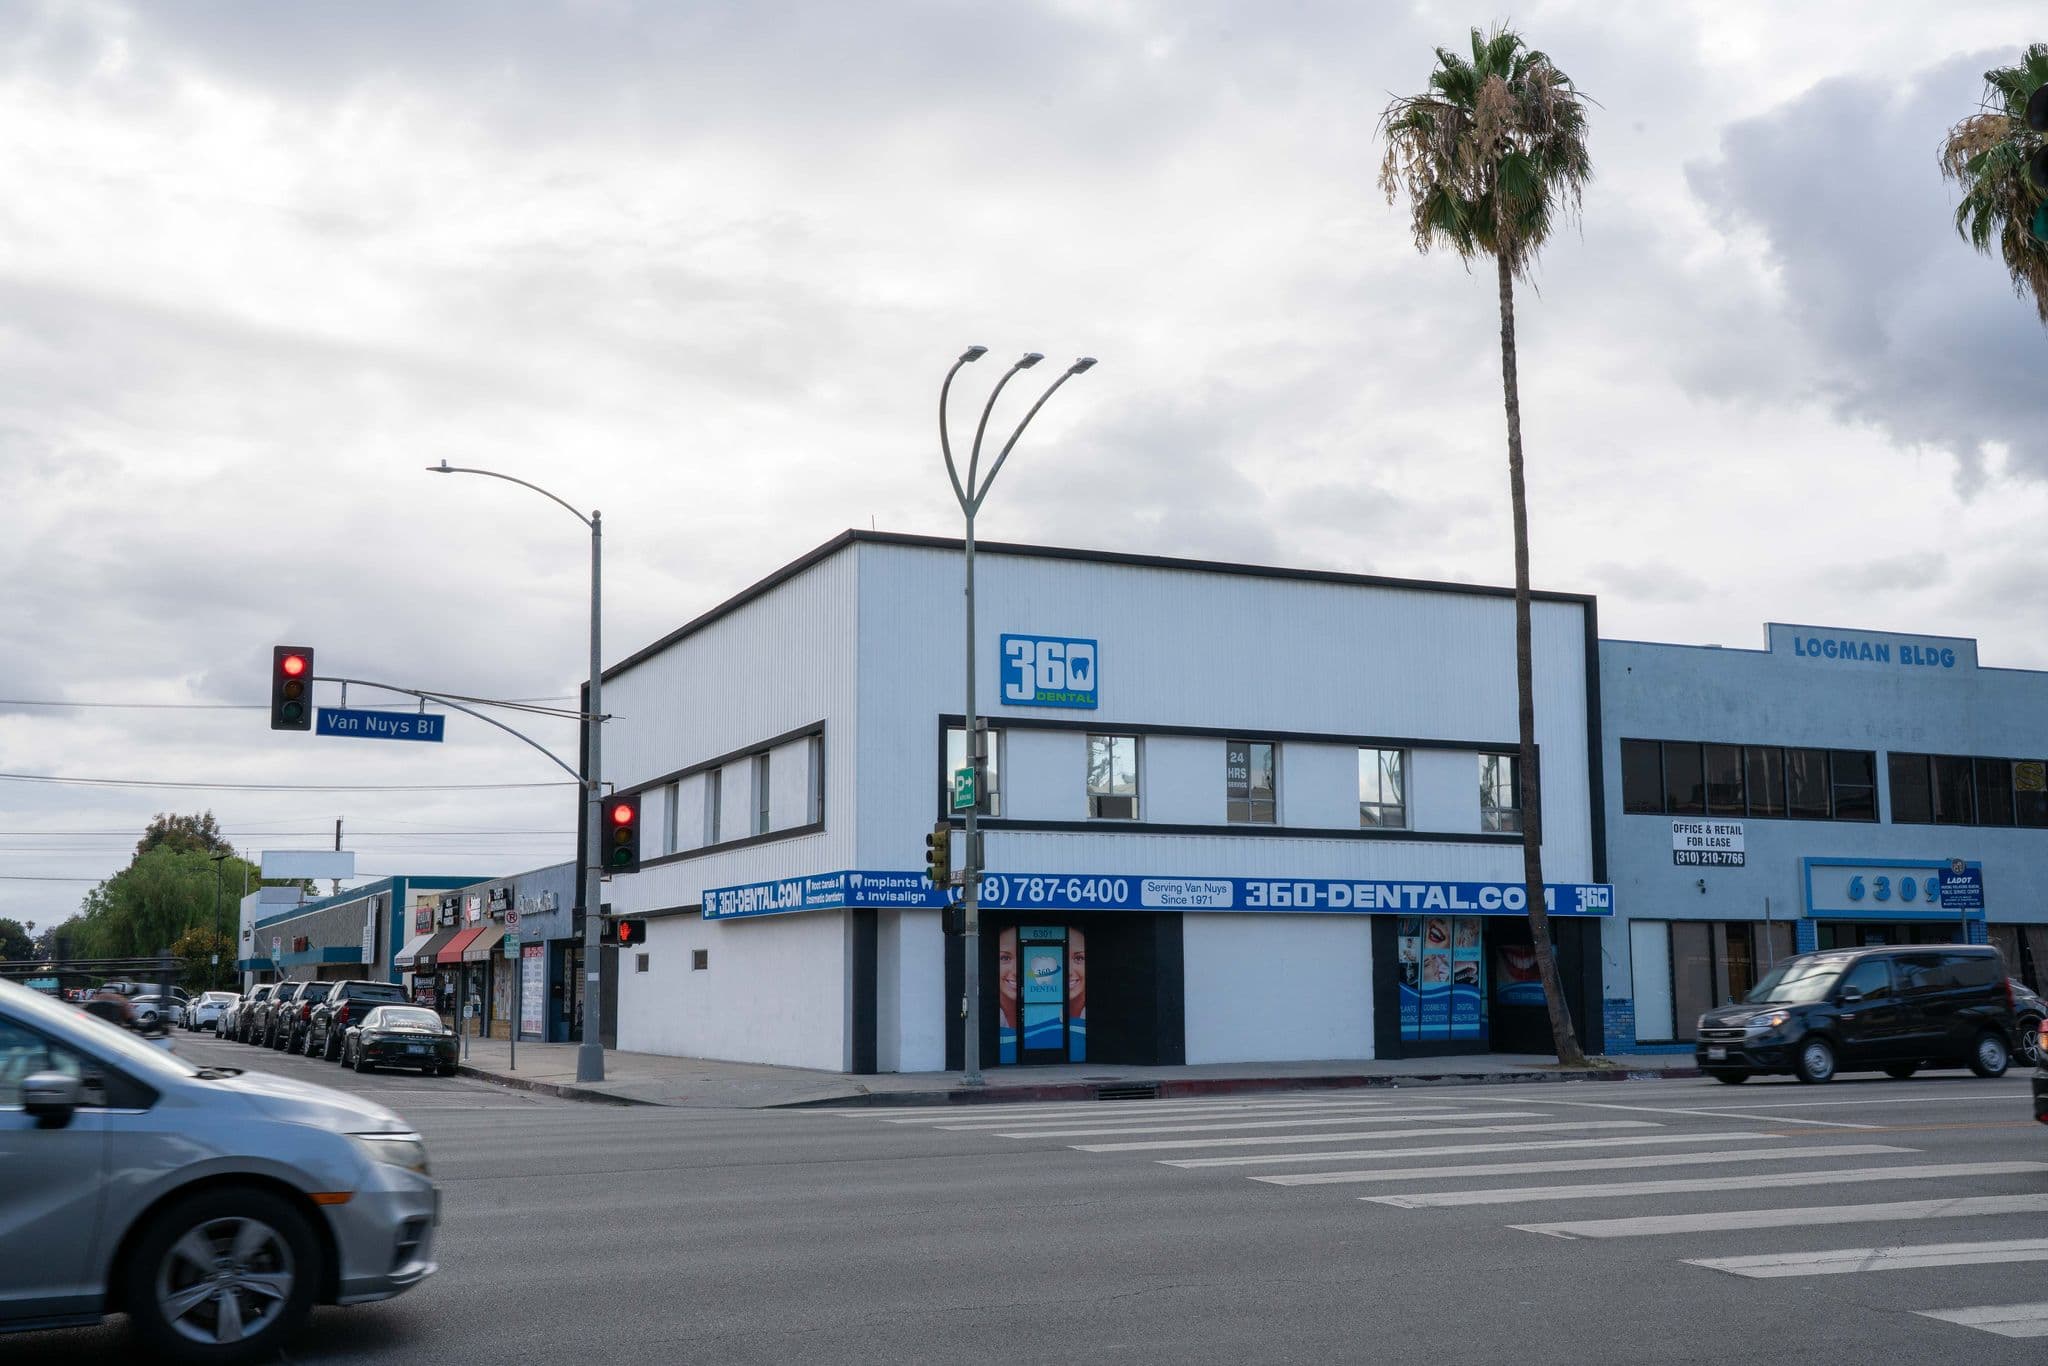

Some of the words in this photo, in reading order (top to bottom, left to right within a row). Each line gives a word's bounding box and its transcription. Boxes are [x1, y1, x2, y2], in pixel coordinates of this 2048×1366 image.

[1794, 637, 1890, 663] LOGMAN
[1900, 645, 1955, 668] BLDG
[1005, 639, 1095, 700] 360
[1036, 691, 1095, 704] DENTAL
[327, 714, 358, 730] Van
[366, 717, 410, 735] Nuys
[417, 720, 435, 734] Bl
[1230, 752, 1245, 763] 24
[1228, 768, 1247, 779] HRS
[1673, 823, 1703, 834] OFFICE
[1705, 824, 1712, 834] &
[1714, 825, 1743, 836] RETAIL
[1687, 836, 1704, 847] FOR
[1705, 837, 1731, 847] LEASE
[1676, 851, 1700, 865] (310)
[1701, 851, 1744, 865] 210-7766
[864, 876, 918, 889] Implants
[1946, 876, 1973, 884] LADOT
[1013, 877, 1129, 903] 787-6400
[1147, 882, 1183, 894] Serving
[1184, 882, 1202, 893] Van
[1204, 883, 1227, 895] Nuys
[1848, 875, 1941, 902] 6309
[719, 881, 802, 915] 360-DENTAL.COM
[855, 891, 865, 901] &
[868, 890, 926, 904] Invisalign
[1161, 894, 1188, 905] Since
[1190, 895, 1213, 905] 1971
[1575, 886, 1609, 912] 360
[1033, 930, 1053, 938] 6301
[1030, 985, 1058, 993] DENTAL
